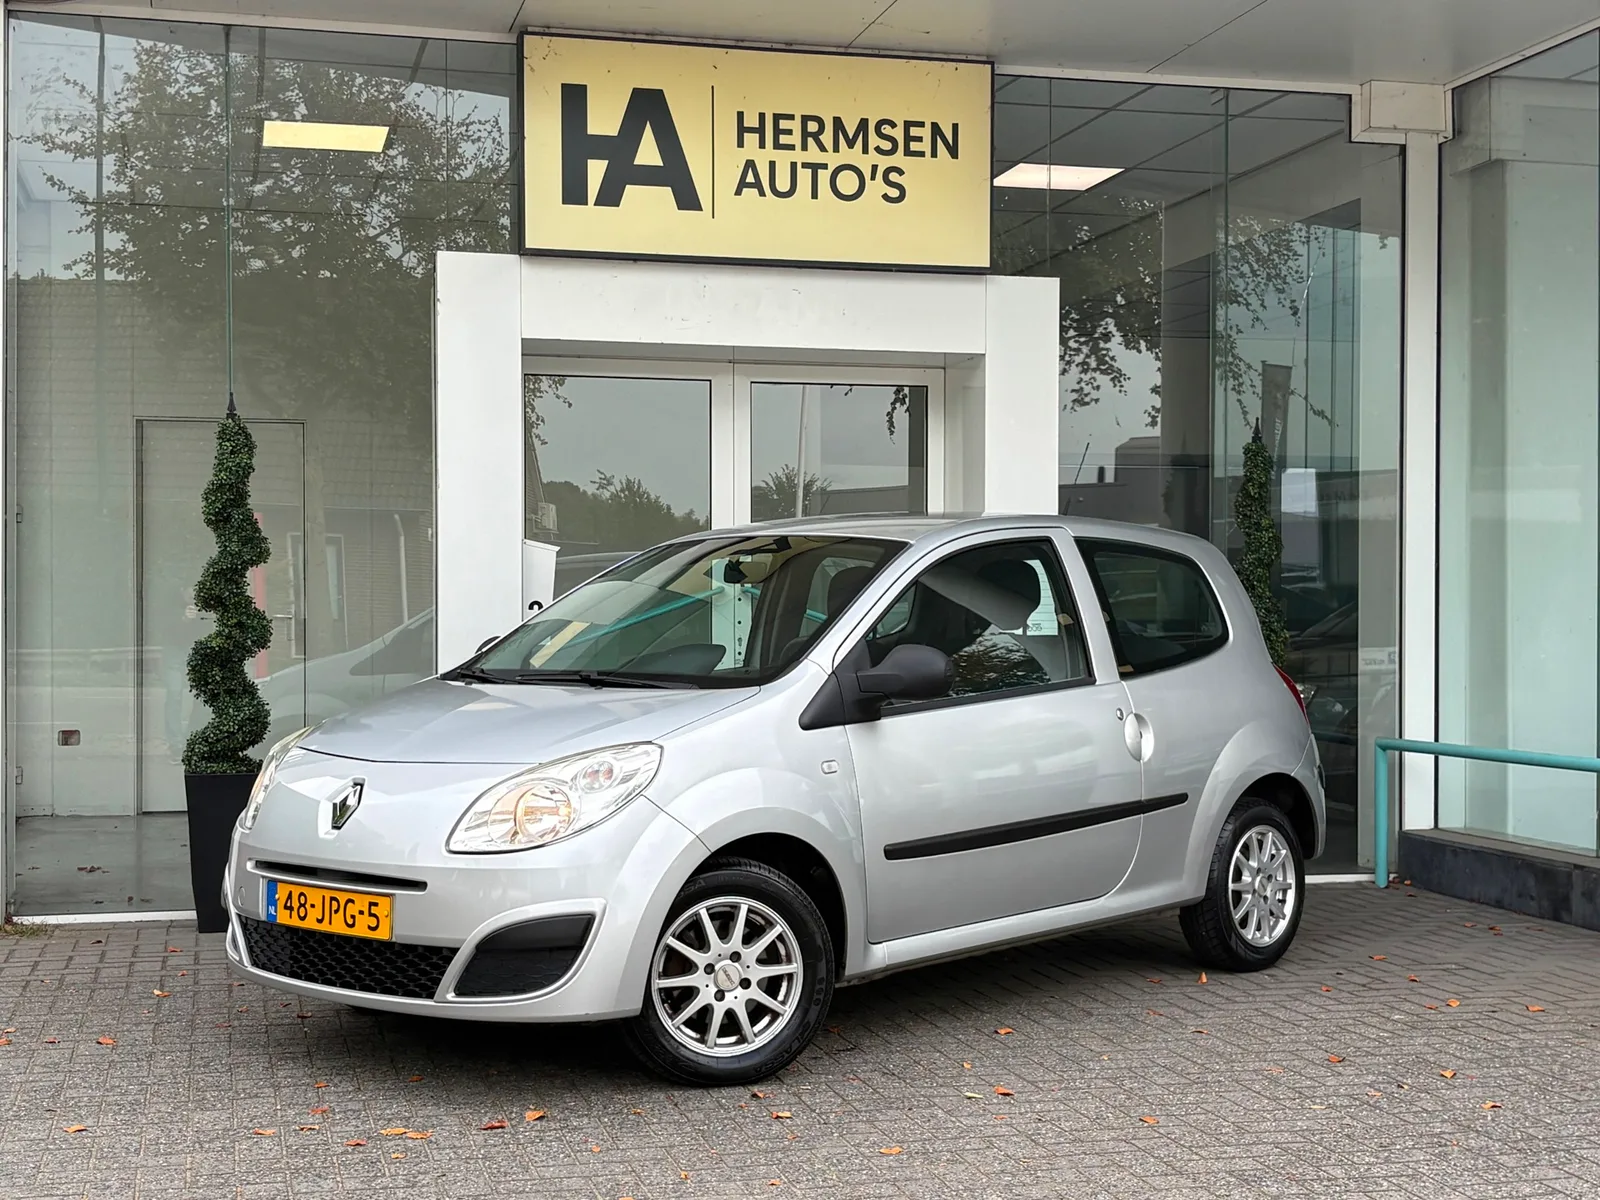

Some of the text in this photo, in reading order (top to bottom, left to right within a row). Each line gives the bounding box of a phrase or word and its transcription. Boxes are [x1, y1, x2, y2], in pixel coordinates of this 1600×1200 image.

[561, 82, 703, 212] HA
[736, 110, 960, 160] HERMSEN
[734, 159, 907, 205] AUTO'S
[268, 905, 277, 915] NL
[283, 890, 380, 932] 48-JPG-5
